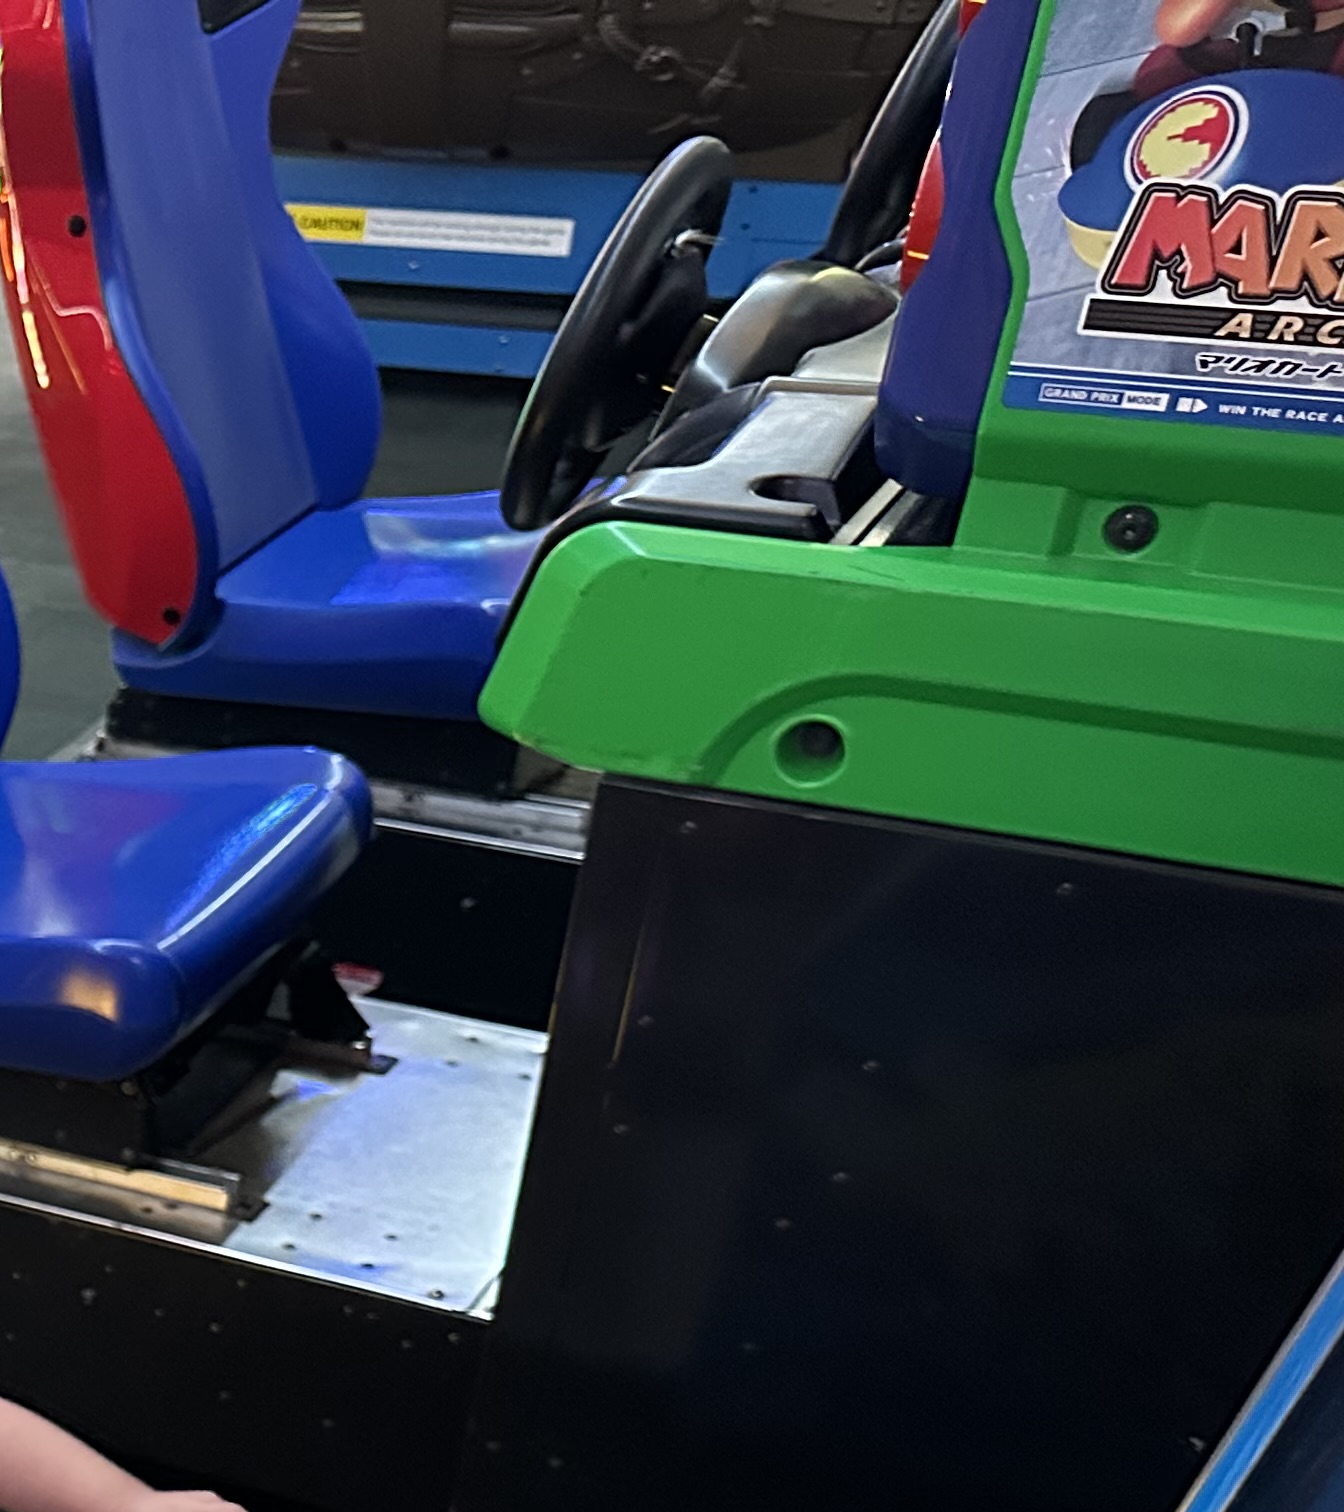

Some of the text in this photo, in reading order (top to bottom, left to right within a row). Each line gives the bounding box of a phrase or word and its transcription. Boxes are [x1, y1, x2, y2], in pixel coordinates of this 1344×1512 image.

[1109, 190, 1344, 302] MAR
[1044, 387, 1161, 406] GRAND PRIX MODE
[1218, 404, 1247, 415] WIN
[1252, 406, 1282, 418] THE
[1285, 409, 1328, 422] RACE
